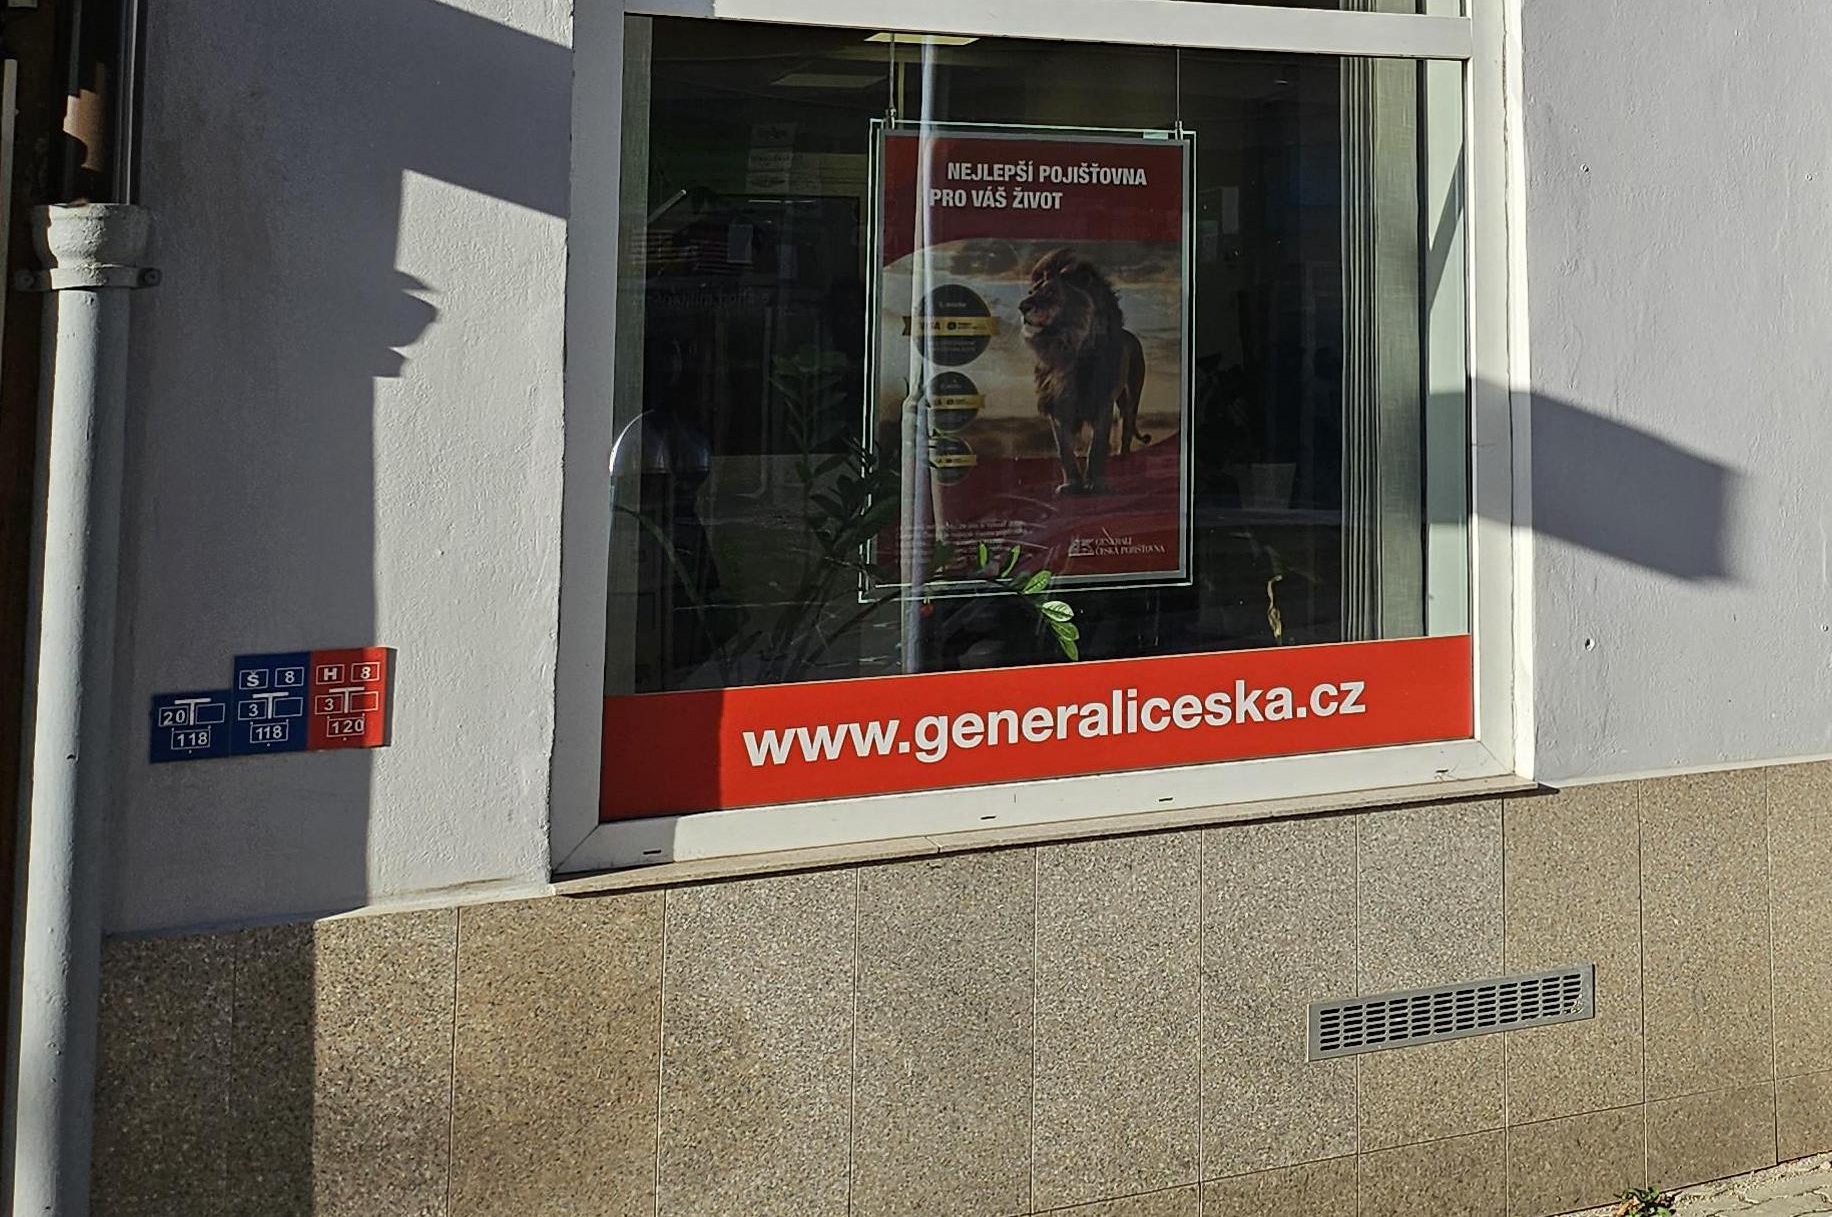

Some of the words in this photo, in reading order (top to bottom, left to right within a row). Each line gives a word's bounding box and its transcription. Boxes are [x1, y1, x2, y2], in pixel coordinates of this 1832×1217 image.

[947, 160, 1033, 182] NEJLEPŠÍ
[1039, 162, 1148, 185] POJIŠŤOVNA
[929, 188, 967, 207] PRO
[971, 186, 1007, 208] VÁŠ
[1012, 187, 1063, 210] ŽIVOT
[284, 671, 295, 684] 8
[323, 667, 337, 681] H
[360, 666, 371, 679] 8
[248, 703, 259, 717] 3
[324, 697, 335, 711] 3
[163, 710, 185, 725] 20
[742, 679, 1366, 767] www.generaliceska.cz
[255, 725, 282, 740] 118
[332, 720, 364, 734] 120
[177, 732, 208, 747] 118
